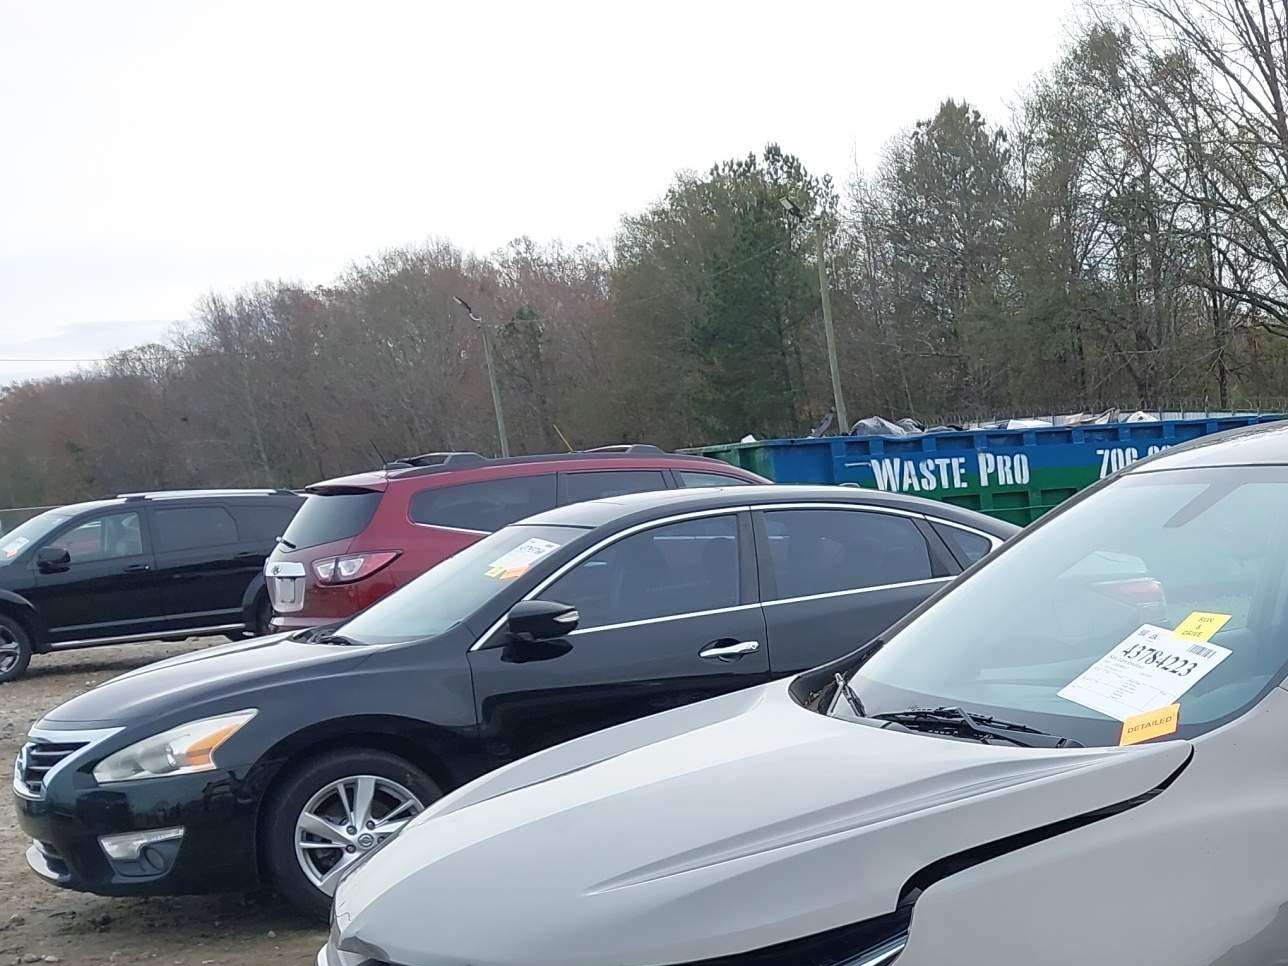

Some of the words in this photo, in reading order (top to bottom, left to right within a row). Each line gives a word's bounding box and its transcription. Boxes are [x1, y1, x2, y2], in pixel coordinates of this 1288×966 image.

[870, 457, 968, 492] WASTE
[978, 452, 1030, 487] PRO
[1122, 643, 1198, 677] 43784223
[1127, 715, 1173, 734] DETAILED
